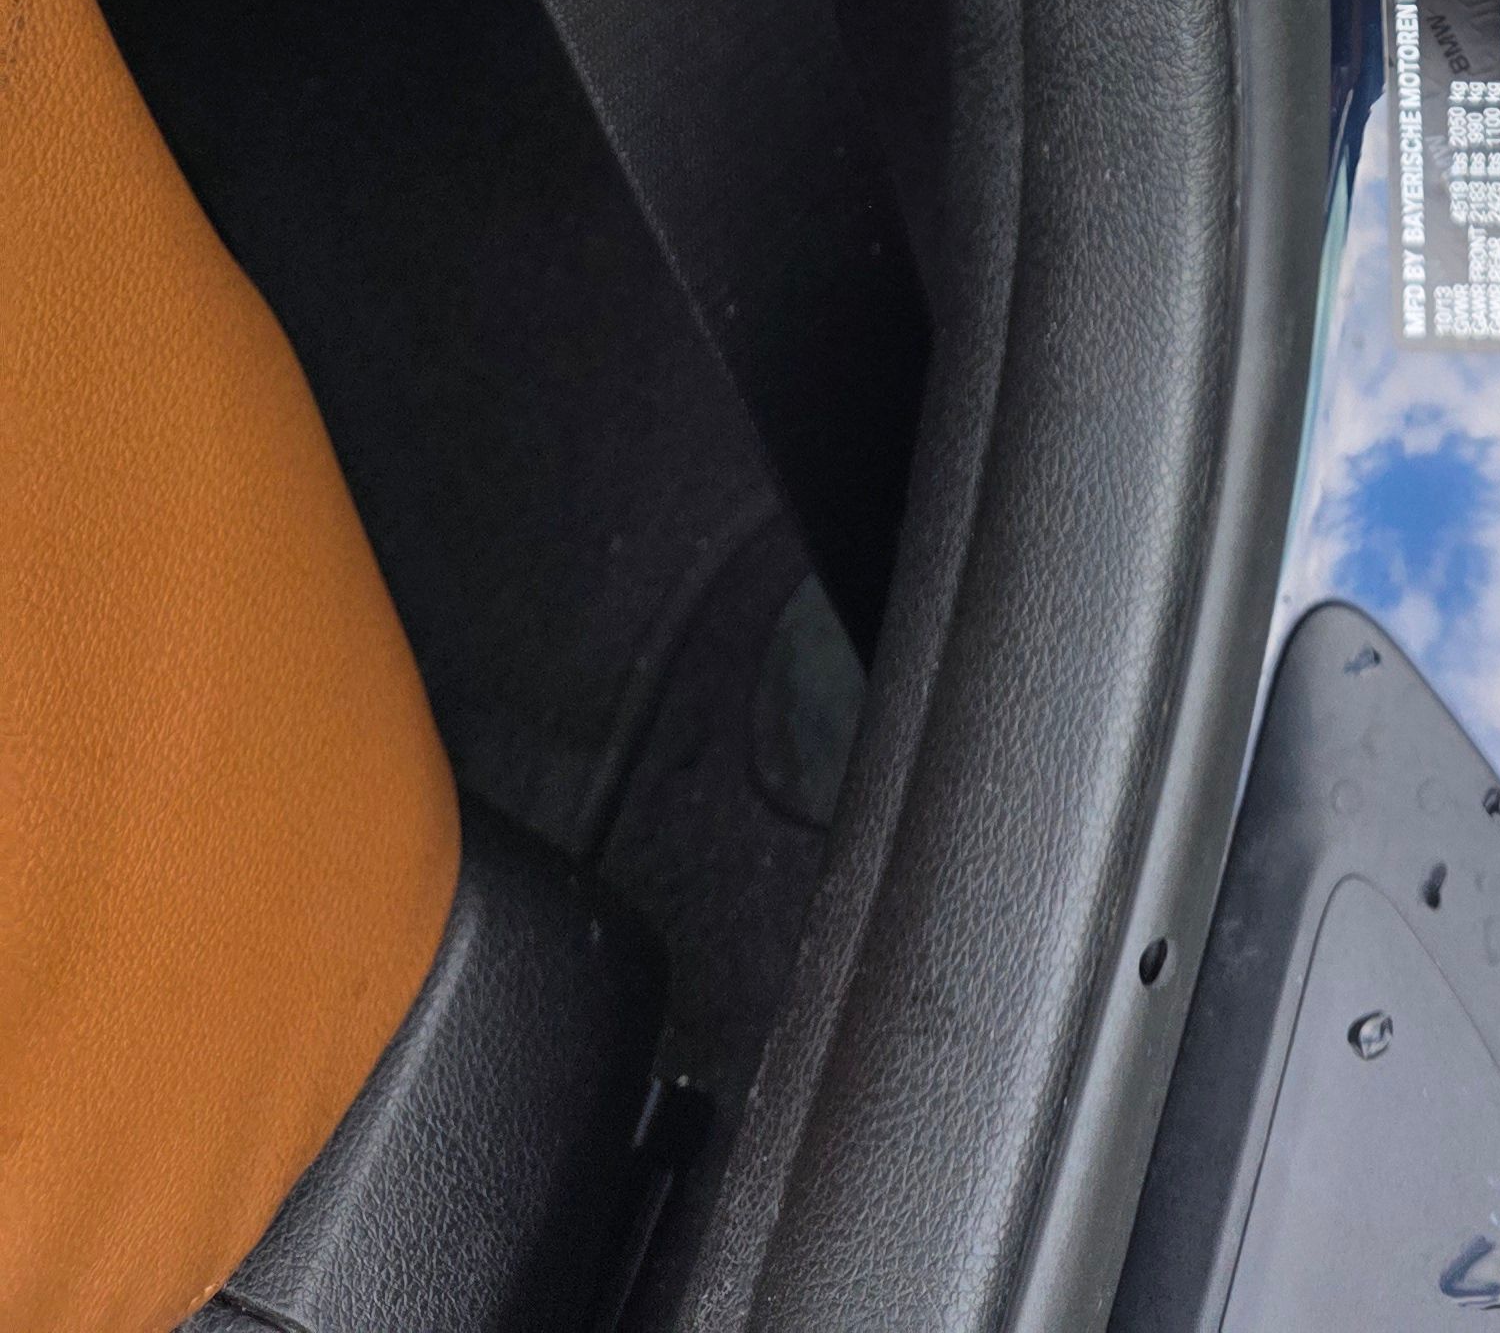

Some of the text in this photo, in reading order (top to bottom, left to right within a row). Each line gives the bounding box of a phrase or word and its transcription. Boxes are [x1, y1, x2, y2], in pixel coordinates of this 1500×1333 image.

[1393, 3, 1421, 108] MOTOREN
[1427, 15, 1470, 76] BMW
[1397, 109, 1425, 245] BAYERISCHE
[1402, 248, 1426, 282] BY
